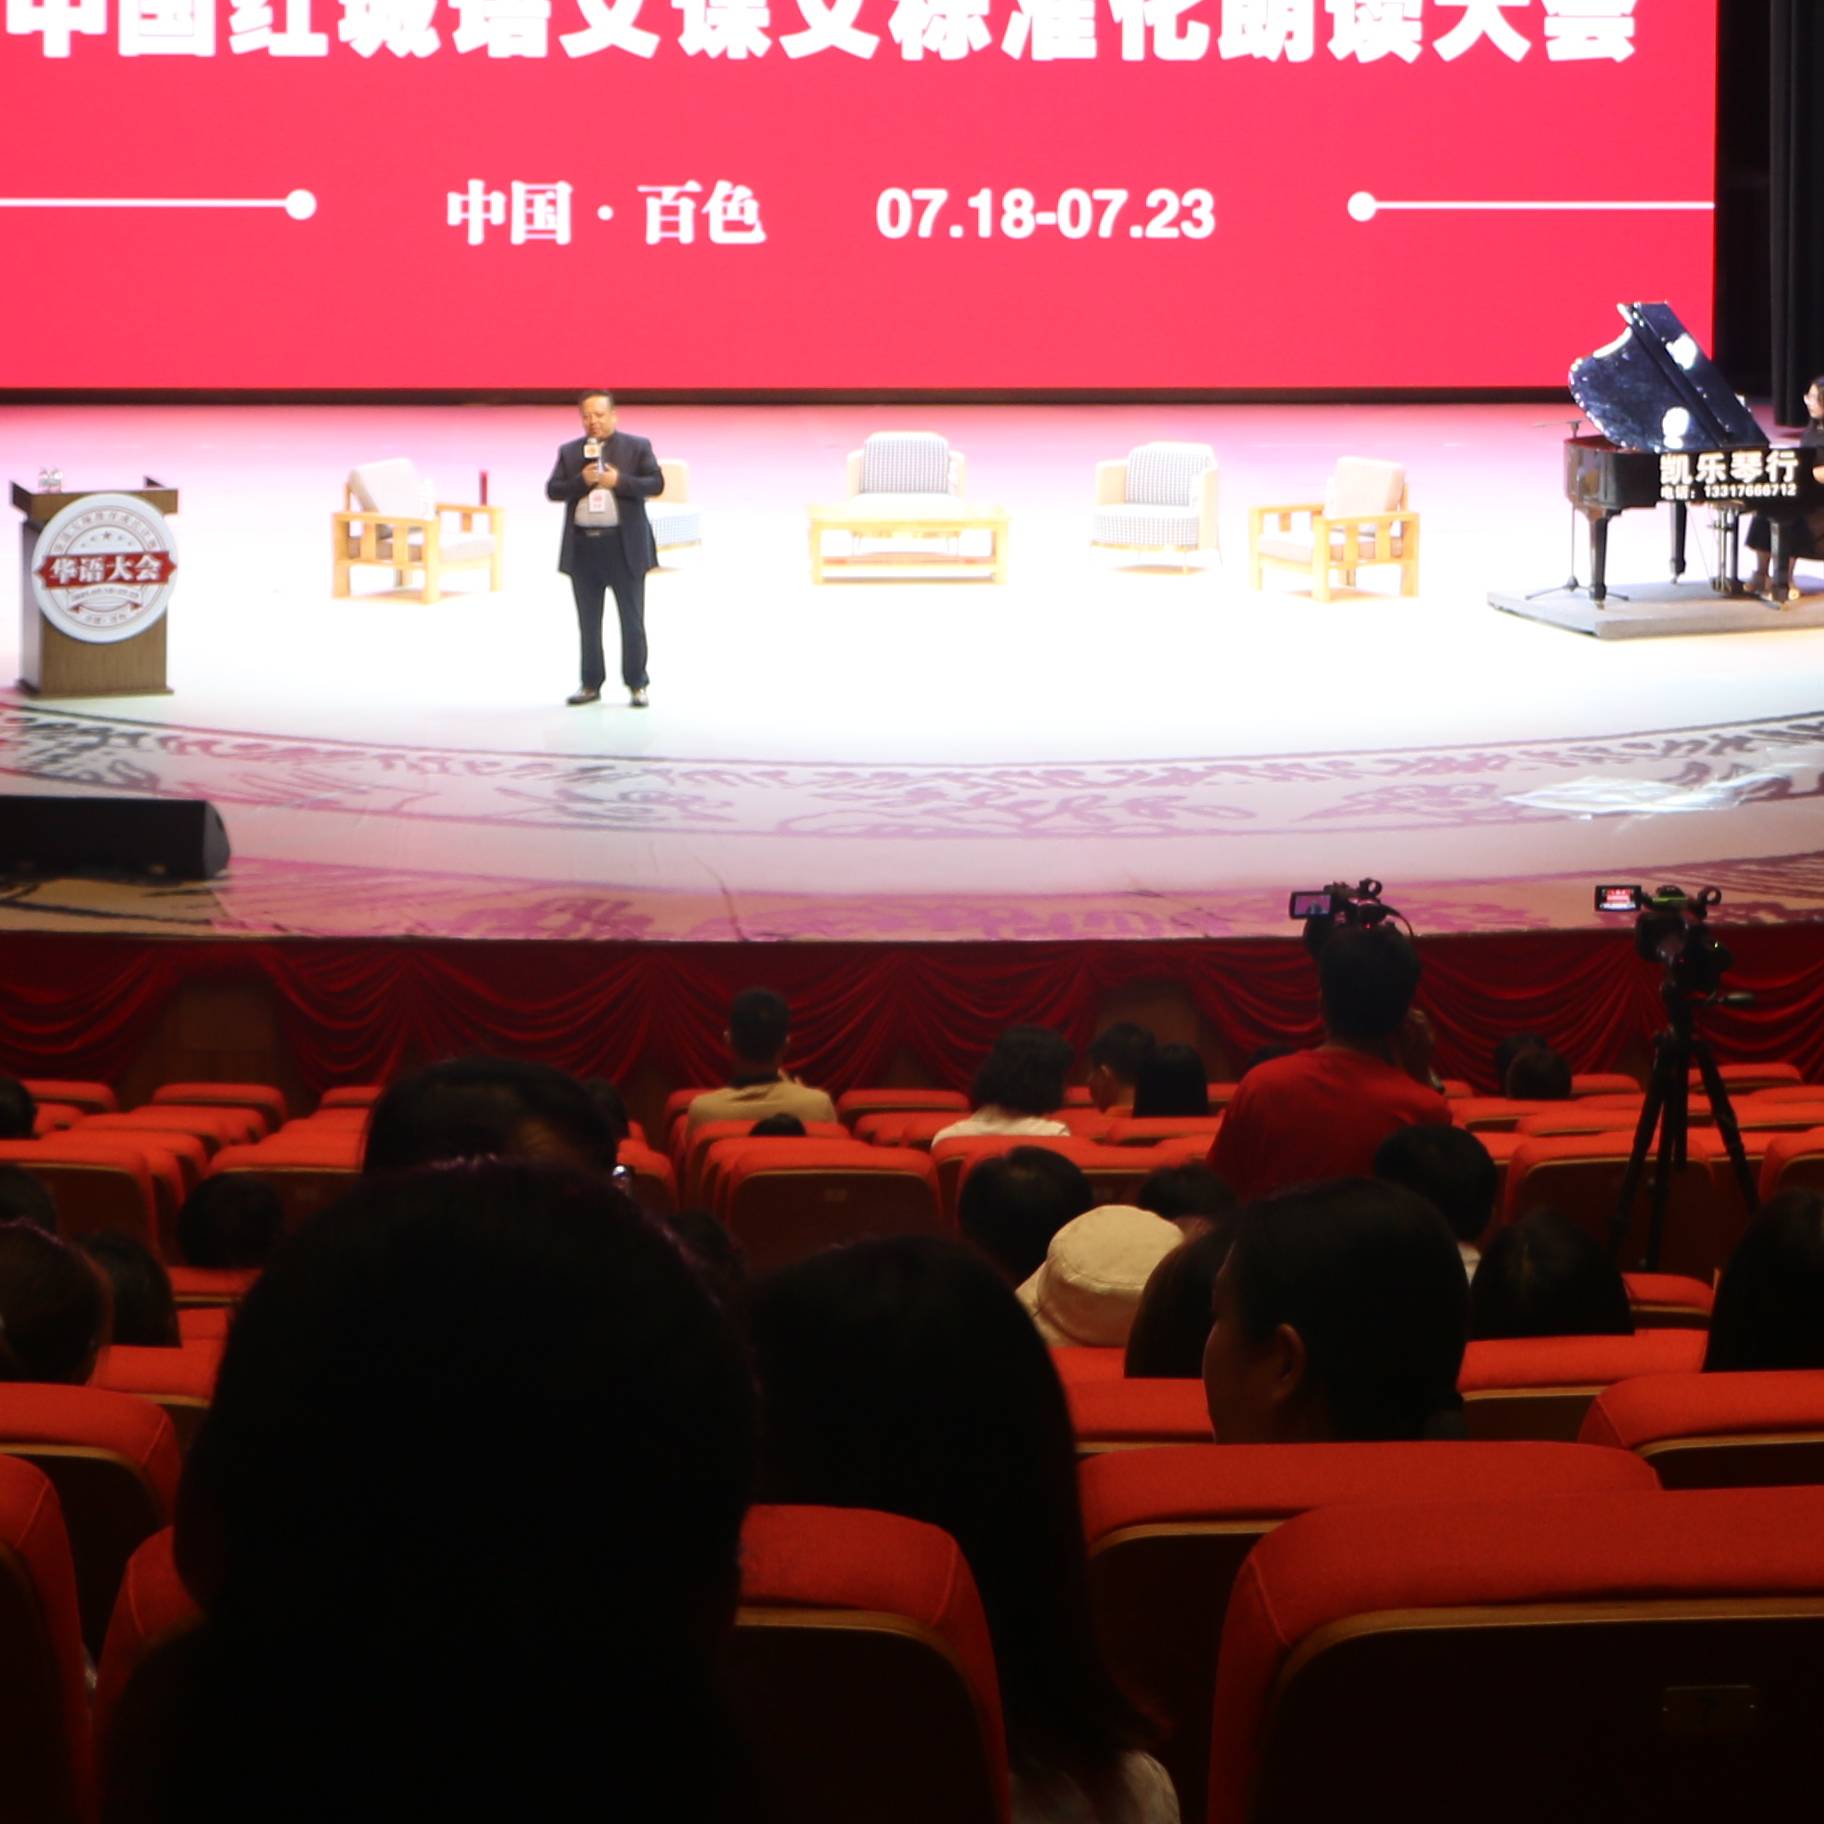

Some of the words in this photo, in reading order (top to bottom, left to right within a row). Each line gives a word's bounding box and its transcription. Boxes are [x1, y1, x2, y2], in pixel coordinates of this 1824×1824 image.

[875, 186, 1218, 240] 07.18-07.23
[1660, 450, 1799, 485] 凯乐琴行
[49, 553, 163, 585] 华语大会
[1695, 1695, 1721, 1729] 7
